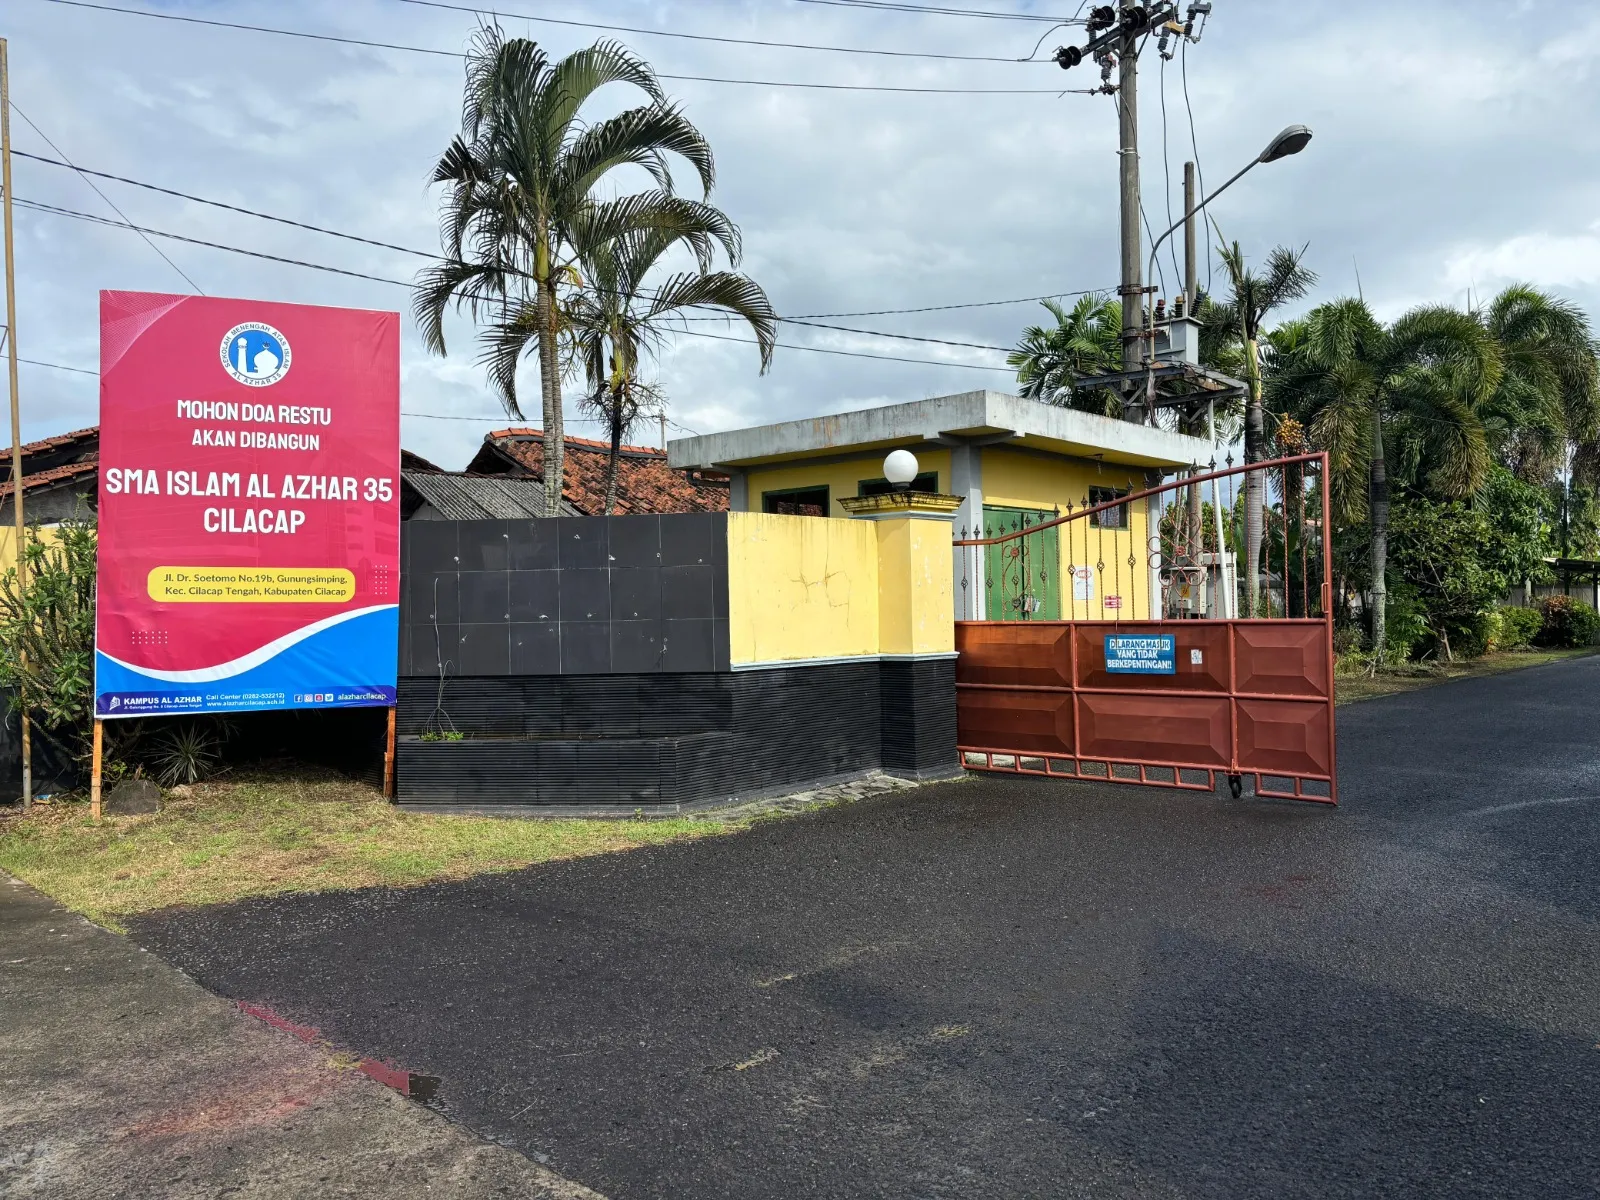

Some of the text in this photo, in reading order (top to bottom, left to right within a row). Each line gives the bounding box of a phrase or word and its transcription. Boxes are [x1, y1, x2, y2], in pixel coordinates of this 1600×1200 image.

[272, 331, 287, 346] ATAS
[232, 371, 241, 380] AL
[243, 377, 271, 386] AZHAR
[177, 399, 332, 426] MOHON DOA RESTU
[192, 428, 320, 451] AKAN DIBANGUN
[105, 467, 393, 502] SMA ISLAM AL AZHAR 35
[203, 507, 306, 534] CILACAP
[163, 573, 348, 585] Jl. Dr. Soetomo No.19b, Gunungsimping,
[165, 586, 347, 598] Kec. Cilacap Tengah, Kabupaten Cilacap
[1110, 639, 1145, 649] DLARANG
[1117, 650, 1158, 659] YANG TIDAK
[1107, 660, 1172, 669] BERKEPENTINGAN!!
[124, 697, 159, 705] KAMPUS
[337, 692, 387, 701] alazharcilacap
